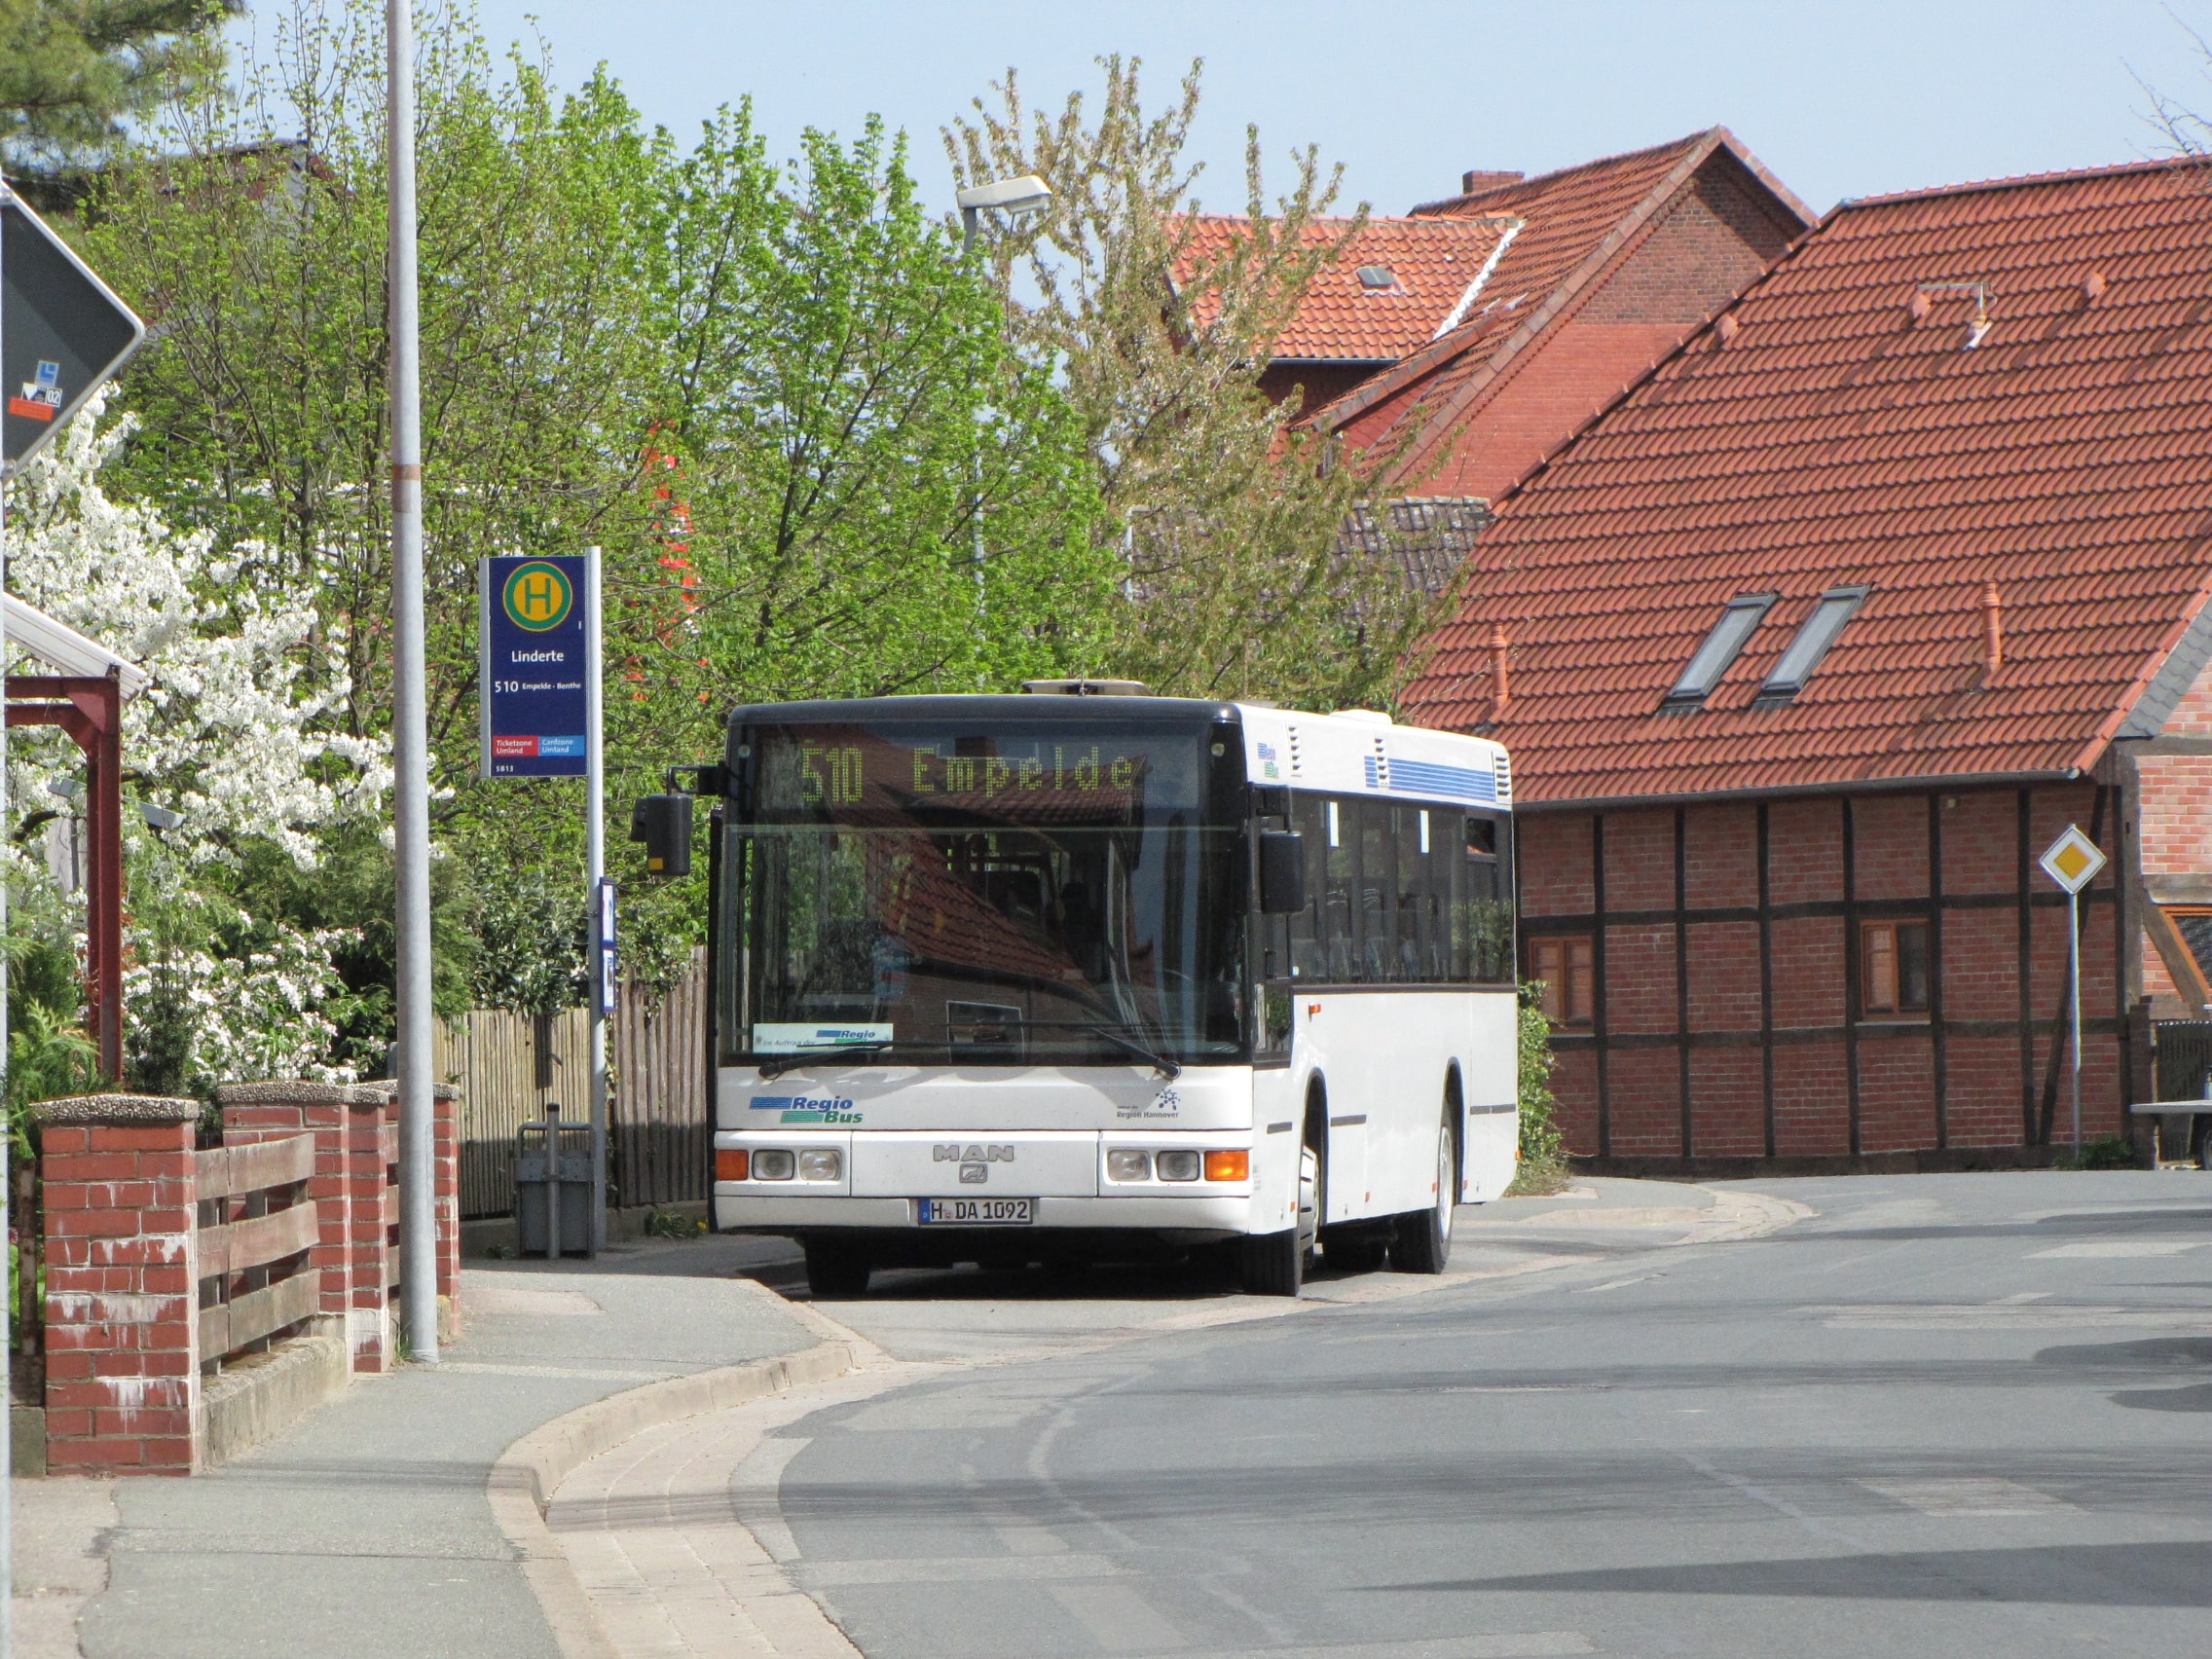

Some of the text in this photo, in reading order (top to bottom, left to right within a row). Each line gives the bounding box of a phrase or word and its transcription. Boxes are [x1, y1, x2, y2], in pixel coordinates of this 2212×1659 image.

[48, 390, 59, 404] 02
[524, 577, 551, 614] H
[511, 649, 565, 663] Linderte
[495, 681, 519, 693] 510
[522, 682, 552, 691] Empelde
[802, 747, 1133, 802] 510 Empelde
[840, 1029, 875, 1039] Regio
[792, 1096, 853, 1113] Regio
[824, 1111, 863, 1124] Bus
[1116, 1111, 1142, 1120] Region
[933, 1144, 1014, 1161] MAN
[931, 1201, 1028, 1220] H DA 1092
